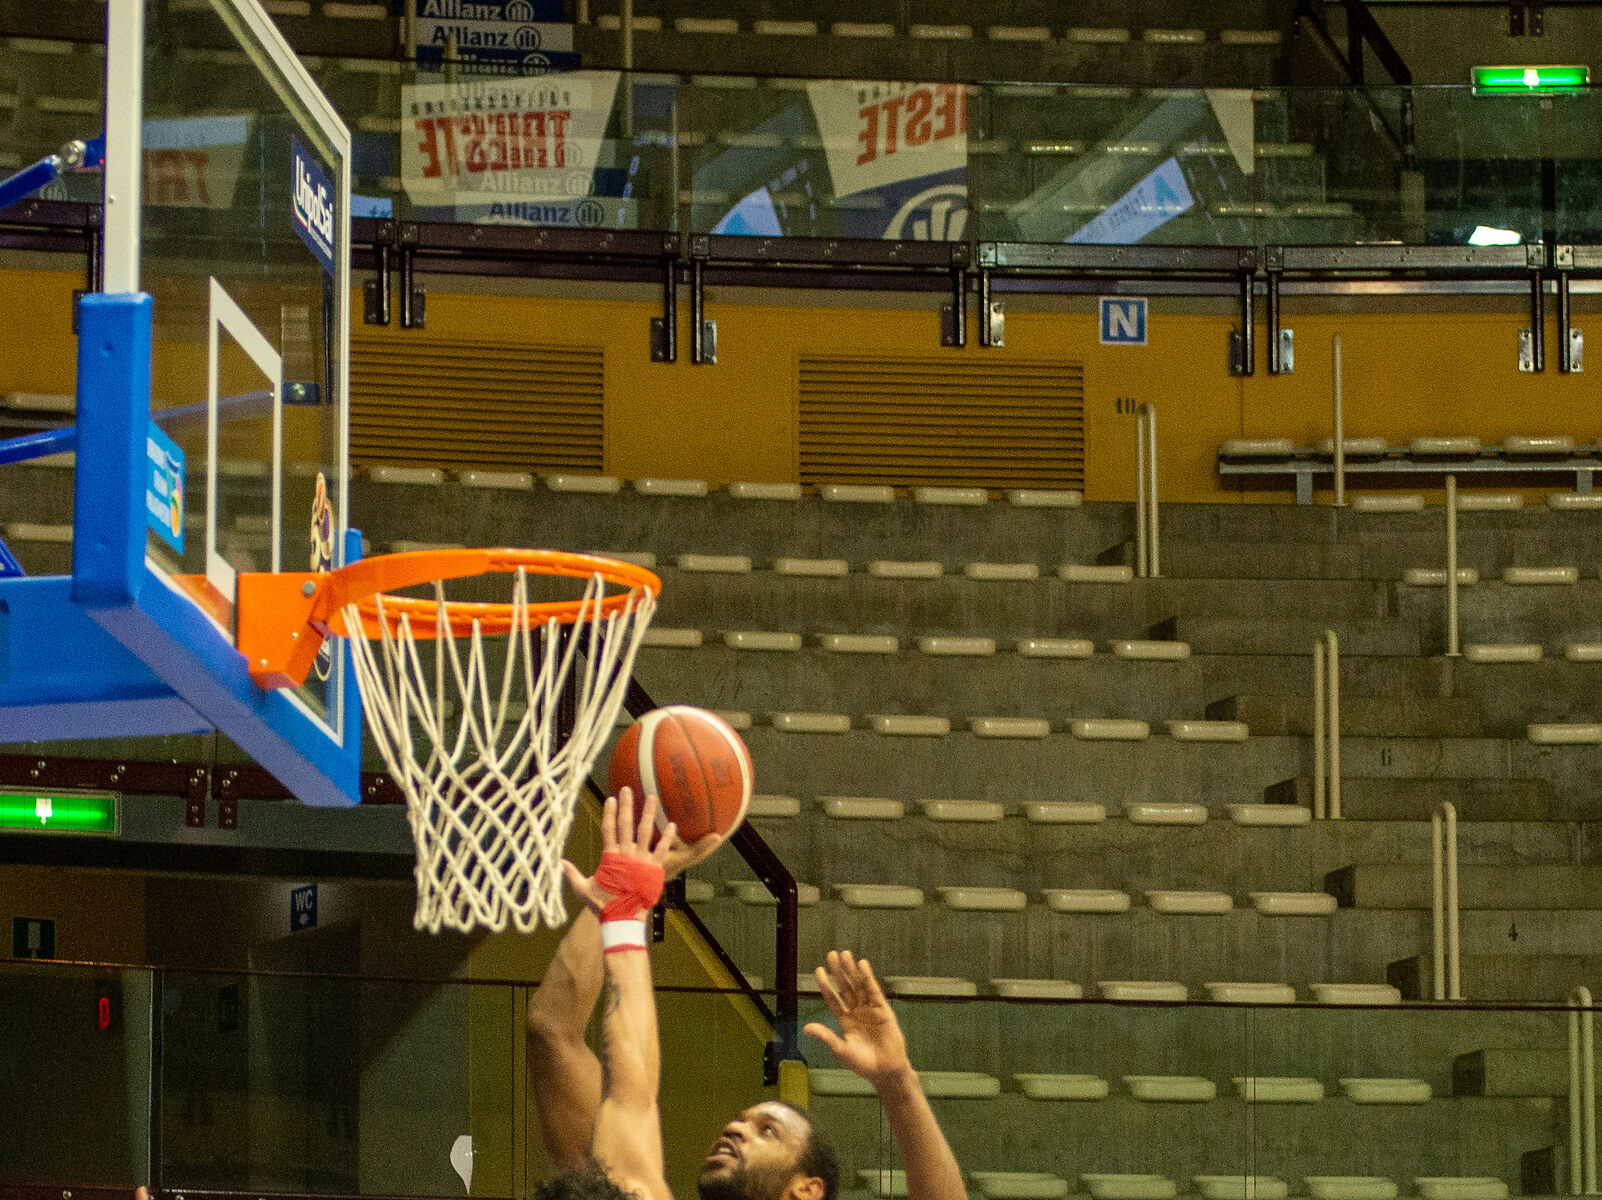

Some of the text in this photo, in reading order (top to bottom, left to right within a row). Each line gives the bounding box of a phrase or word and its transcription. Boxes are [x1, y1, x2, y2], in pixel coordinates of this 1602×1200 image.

[423, 1, 500, 20] Allianz
[432, 26, 509, 47] Allianz
[1109, 303, 1138, 338] N
[296, 889, 313, 912] WC
